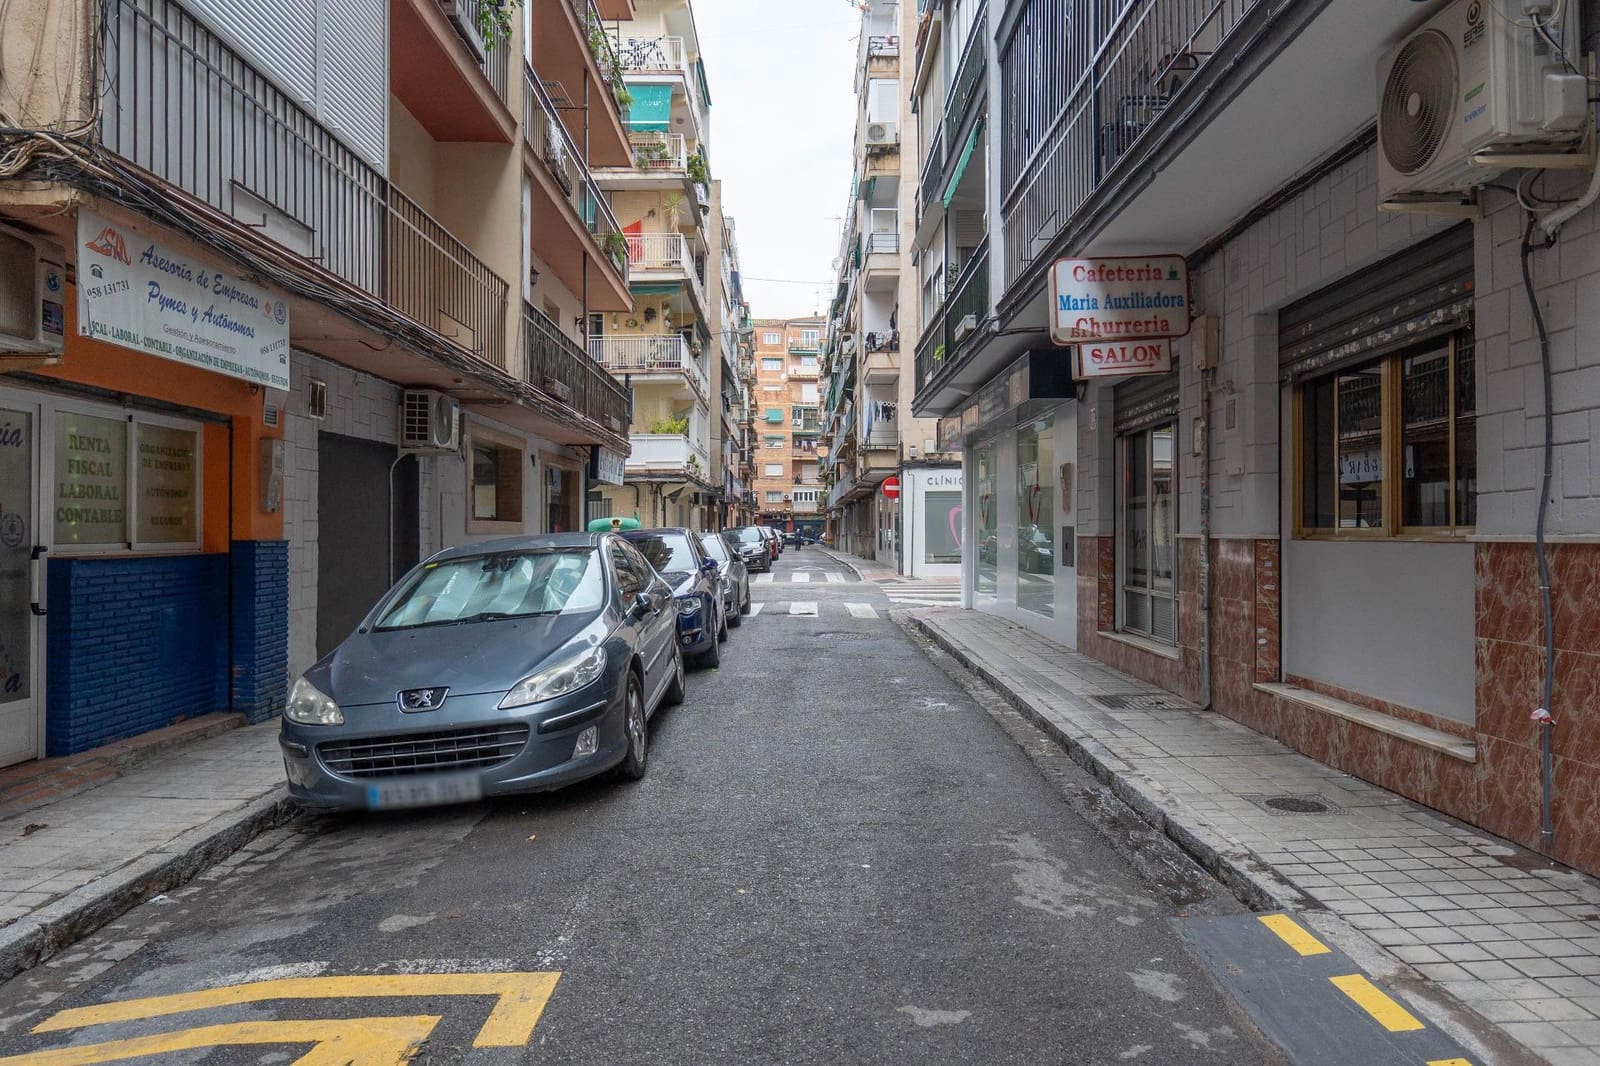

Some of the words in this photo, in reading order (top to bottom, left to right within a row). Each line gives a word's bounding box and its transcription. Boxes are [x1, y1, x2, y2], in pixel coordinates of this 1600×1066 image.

[139, 244, 193, 282] Asesoría
[197, 269, 210, 289] de
[212, 273, 260, 310] Empresas
[1073, 263, 1163, 283] Cafeteria
[86, 285, 102, 299] 958
[103, 279, 131, 297] 131731
[147, 281, 188, 314] Pymes
[191, 306, 200, 324] y
[201, 304, 256, 339] Autónomos
[1058, 293, 1099, 312] Maria
[1104, 291, 1185, 310] Auxiliadora
[1076, 315, 1170, 336] Churreria
[111, 325, 141, 346] LABORAL
[143, 335, 172, 353] CONTABLE
[1091, 344, 1162, 365] SALON
[0, 421, 23, 448] ía
[68, 434, 111, 455] RENTA
[68, 459, 113, 478] FISCAL
[60, 482, 120, 501] LABORAL
[56, 506, 122, 524] CONTABLE
